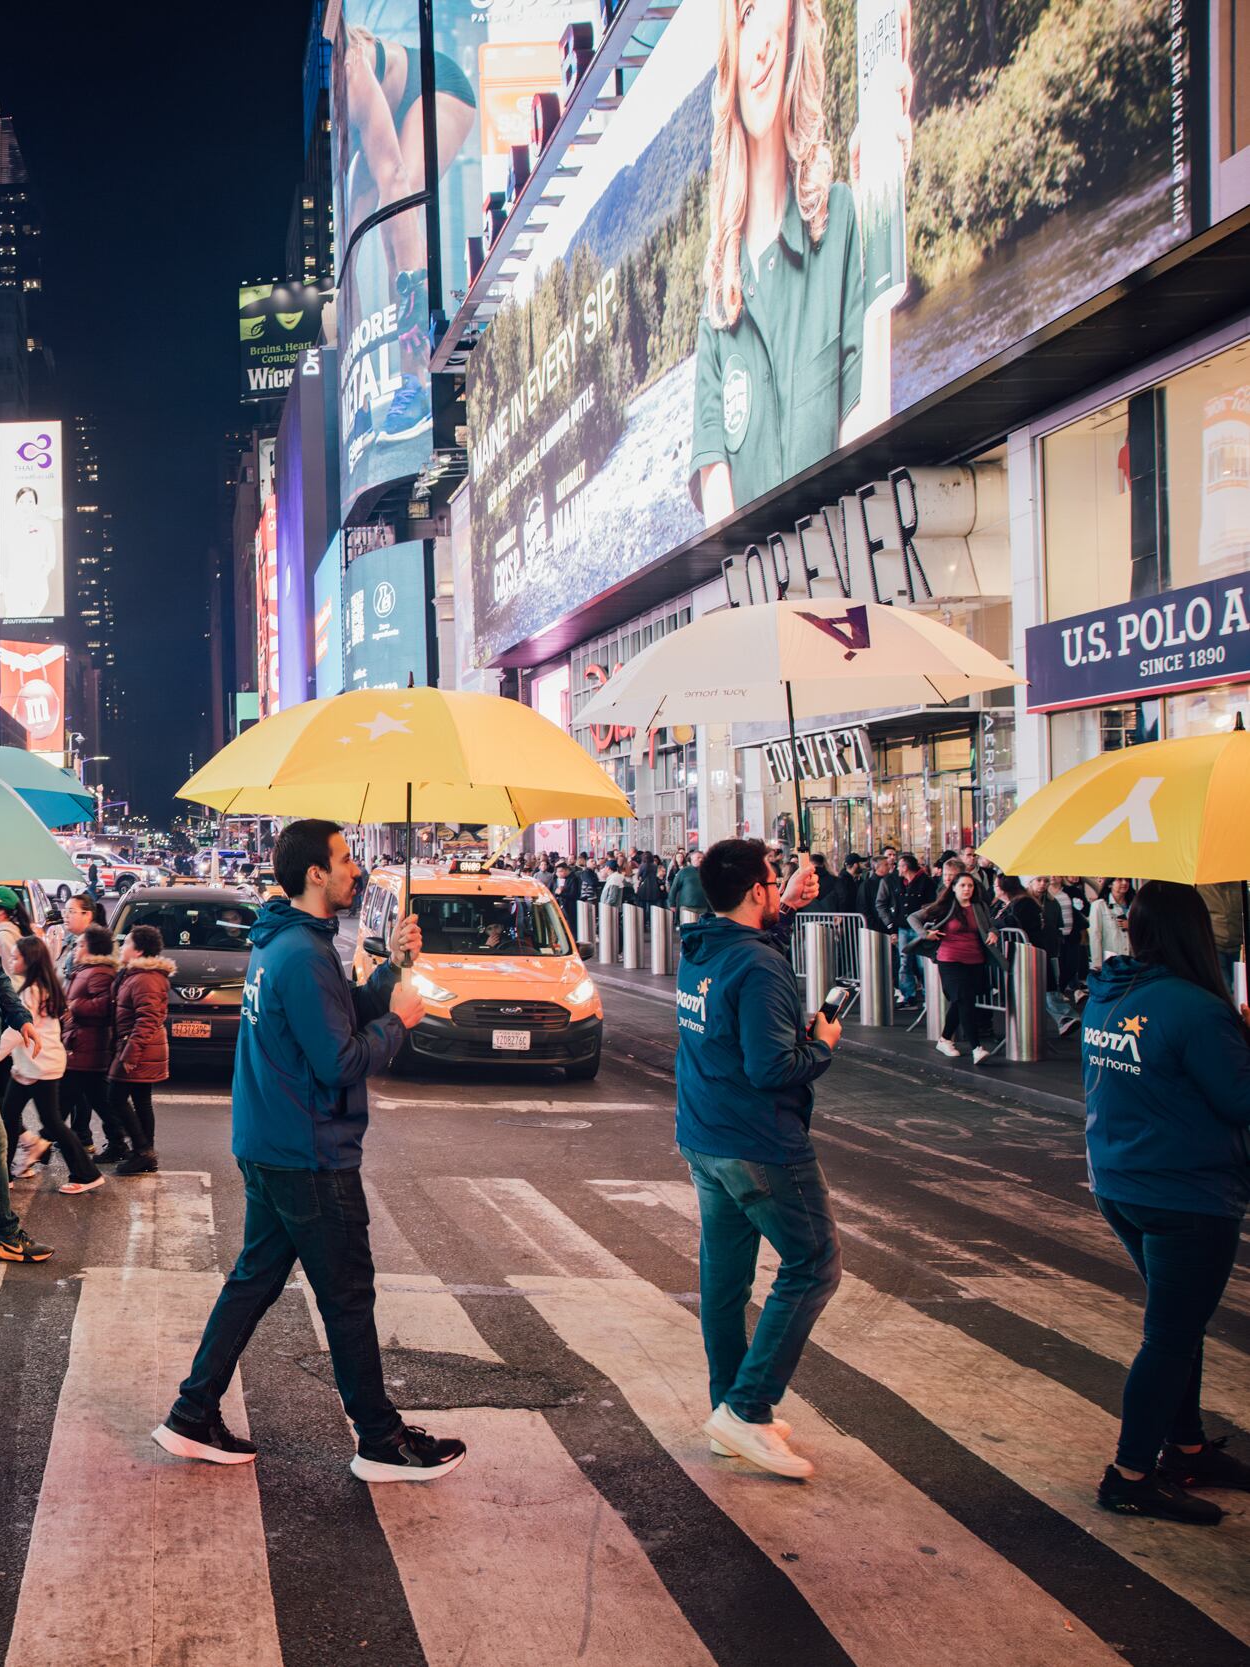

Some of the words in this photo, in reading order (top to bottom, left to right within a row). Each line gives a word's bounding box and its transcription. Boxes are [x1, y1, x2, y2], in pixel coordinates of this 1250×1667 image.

[1171, 25, 1183, 50] BE
[1171, 52, 1183, 86] NOT
[1171, 88, 1184, 122] MAY
[1172, 123, 1184, 184] BOTTLE
[1173, 185, 1185, 224] THIS
[250, 344, 284, 356] Brains.
[285, 341, 315, 353] Heart.
[473, 405, 510, 483] MAINE
[510, 385, 525, 436] IN
[527, 312, 580, 417] EVERY
[583, 267, 618, 344] SIP.
[1061, 621, 1112, 667] U.S.
[1117, 597, 1212, 656] POLO
[1140, 653, 1184, 677] SINCE
[1188, 645, 1226, 669] 1890
[762, 733, 846, 786] FOREVER
[460, 861, 481, 872] 6N89
[1089, 1054, 1105, 1066] your
[1106, 1056, 1142, 1075] home
